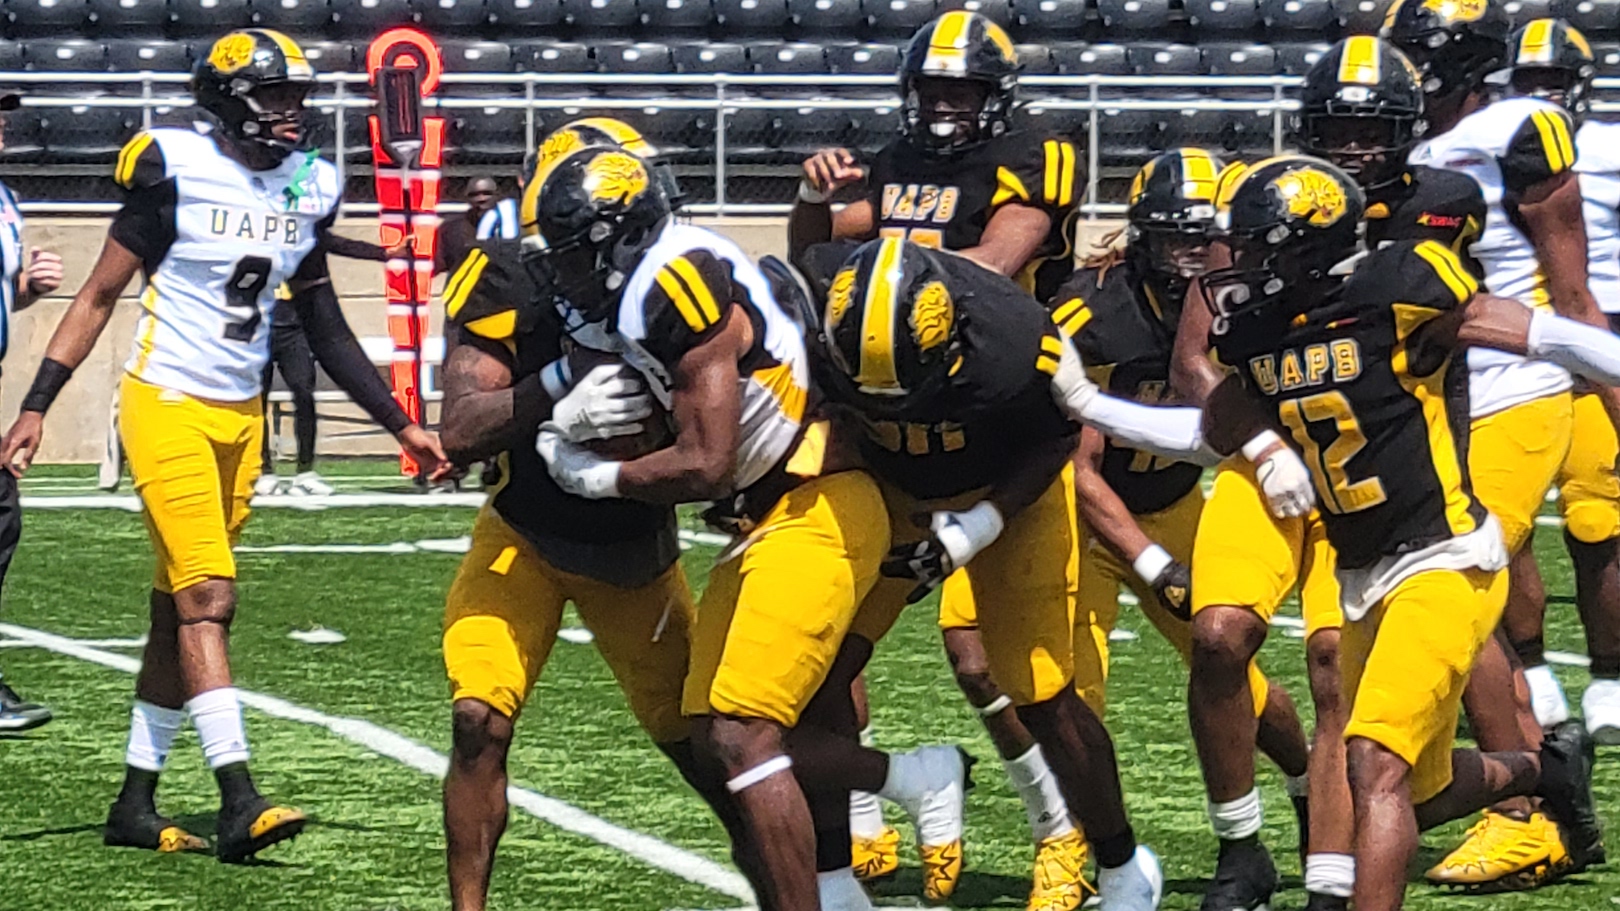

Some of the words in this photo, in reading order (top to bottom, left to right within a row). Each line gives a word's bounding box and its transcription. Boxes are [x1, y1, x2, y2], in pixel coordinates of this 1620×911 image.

[210, 208, 298, 245] UAPB
[223, 254, 273, 343] 9
[1249, 338, 1361, 395] UAPB
[1279, 390, 1387, 515] 12
